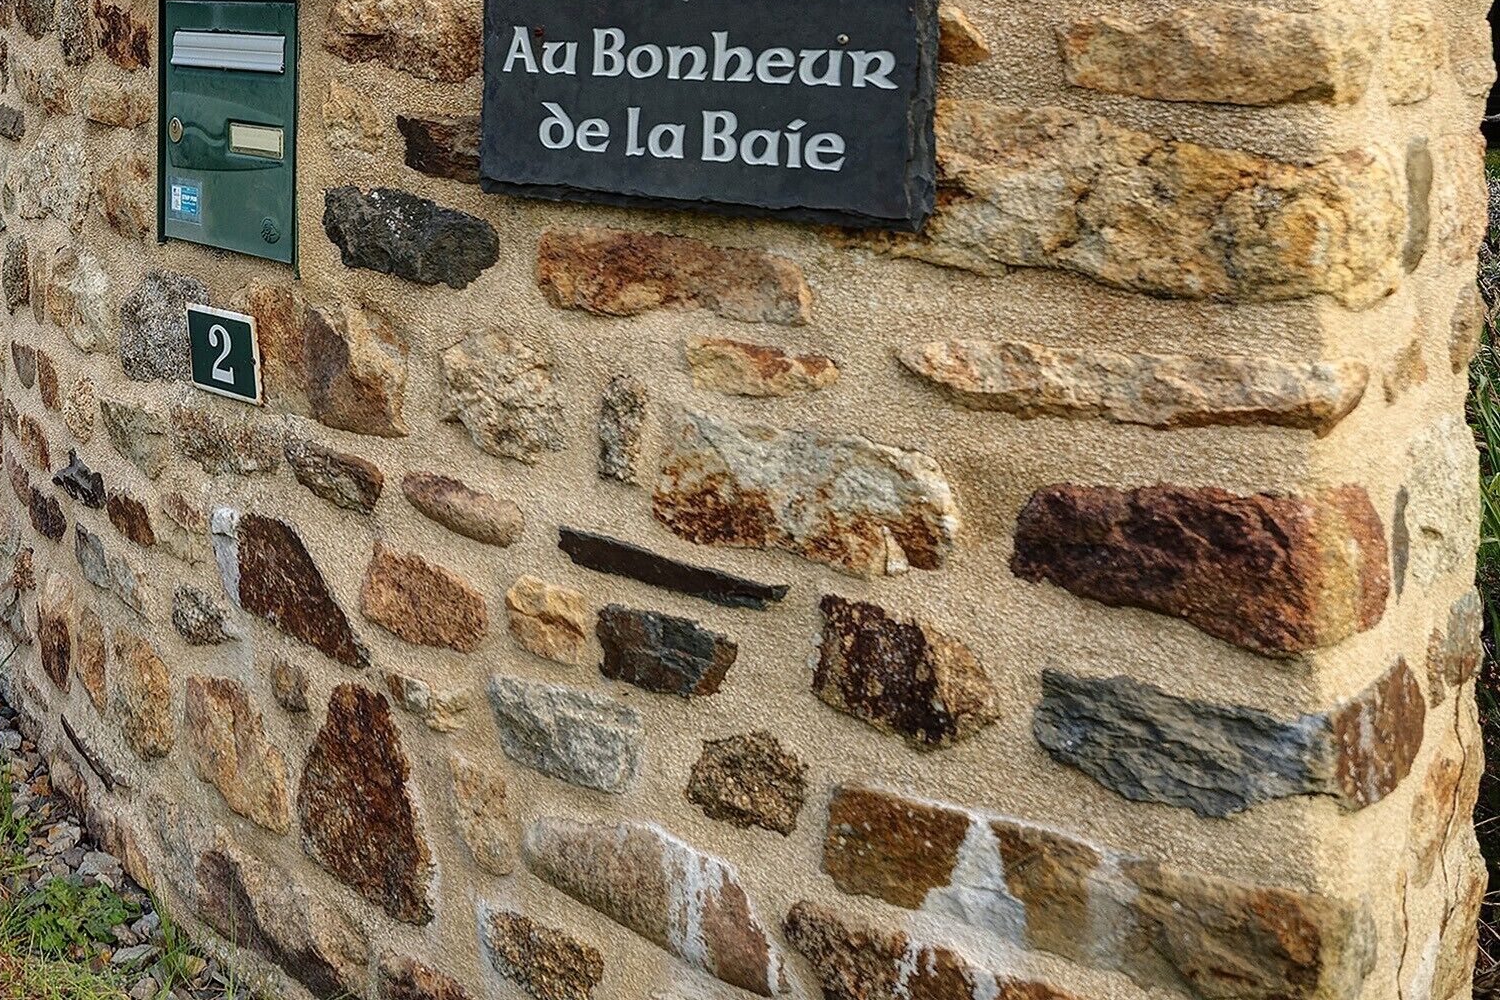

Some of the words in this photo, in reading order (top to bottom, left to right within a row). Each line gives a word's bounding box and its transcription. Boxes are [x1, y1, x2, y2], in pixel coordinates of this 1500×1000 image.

[502, 26, 578, 75] Au
[592, 27, 899, 90] Bonheur
[538, 101, 611, 153] de
[625, 107, 686, 159] la
[701, 110, 846, 172] Baie
[208, 324, 235, 385] 2
